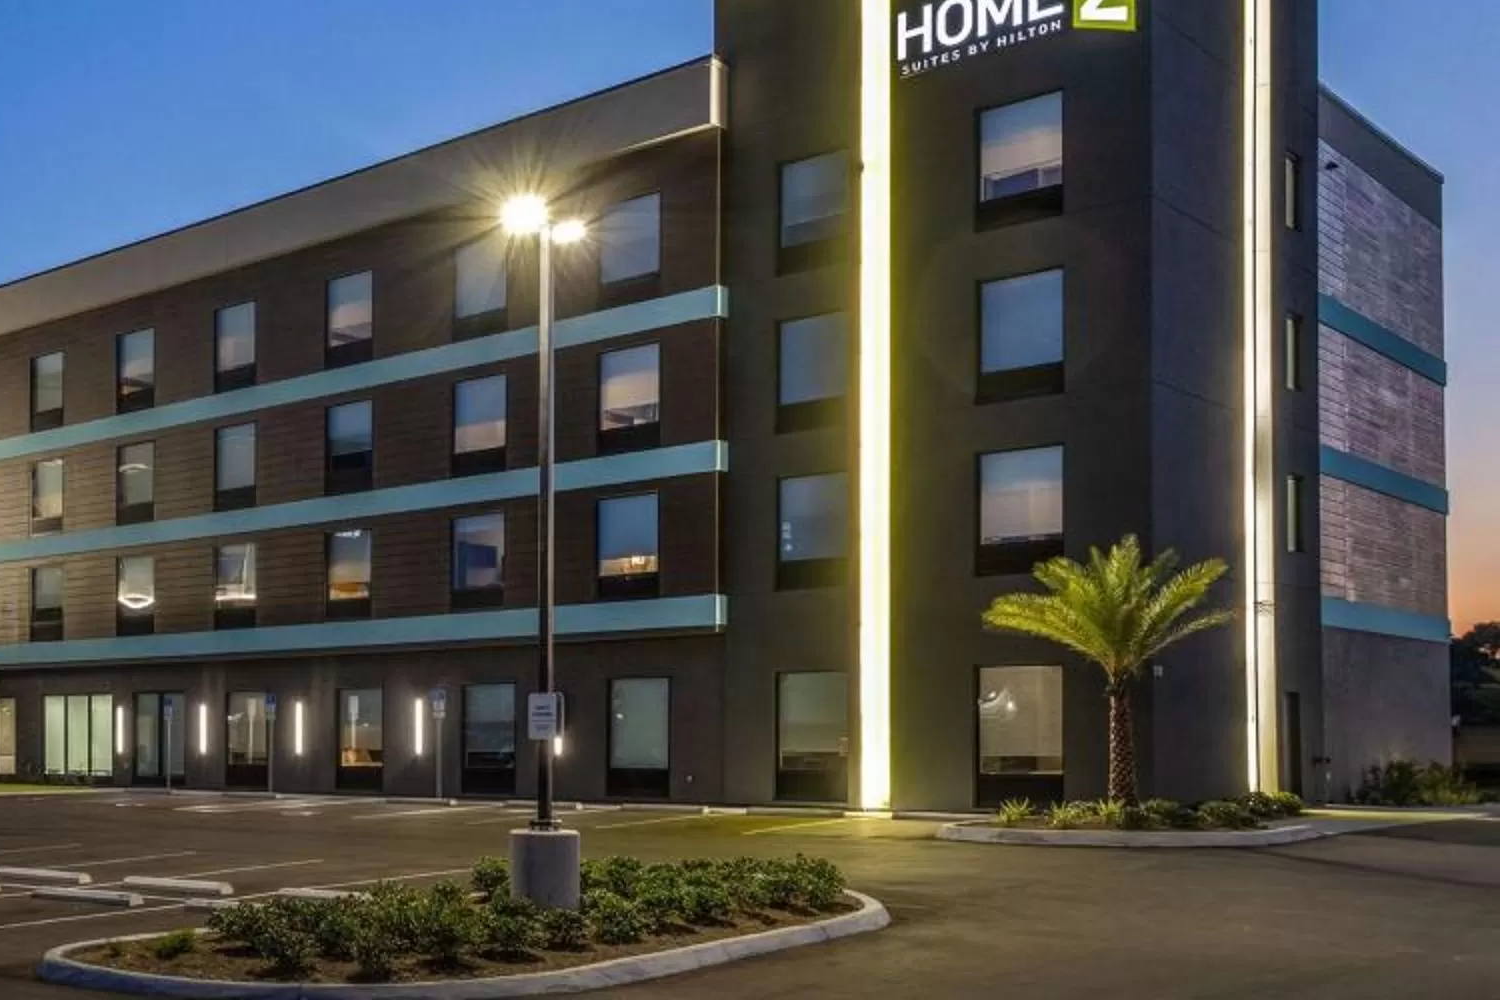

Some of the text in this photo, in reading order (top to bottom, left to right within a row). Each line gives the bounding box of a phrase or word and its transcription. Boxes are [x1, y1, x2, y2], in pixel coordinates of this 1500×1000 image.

[901, 19, 1062, 76] SUITES BY HILTON
